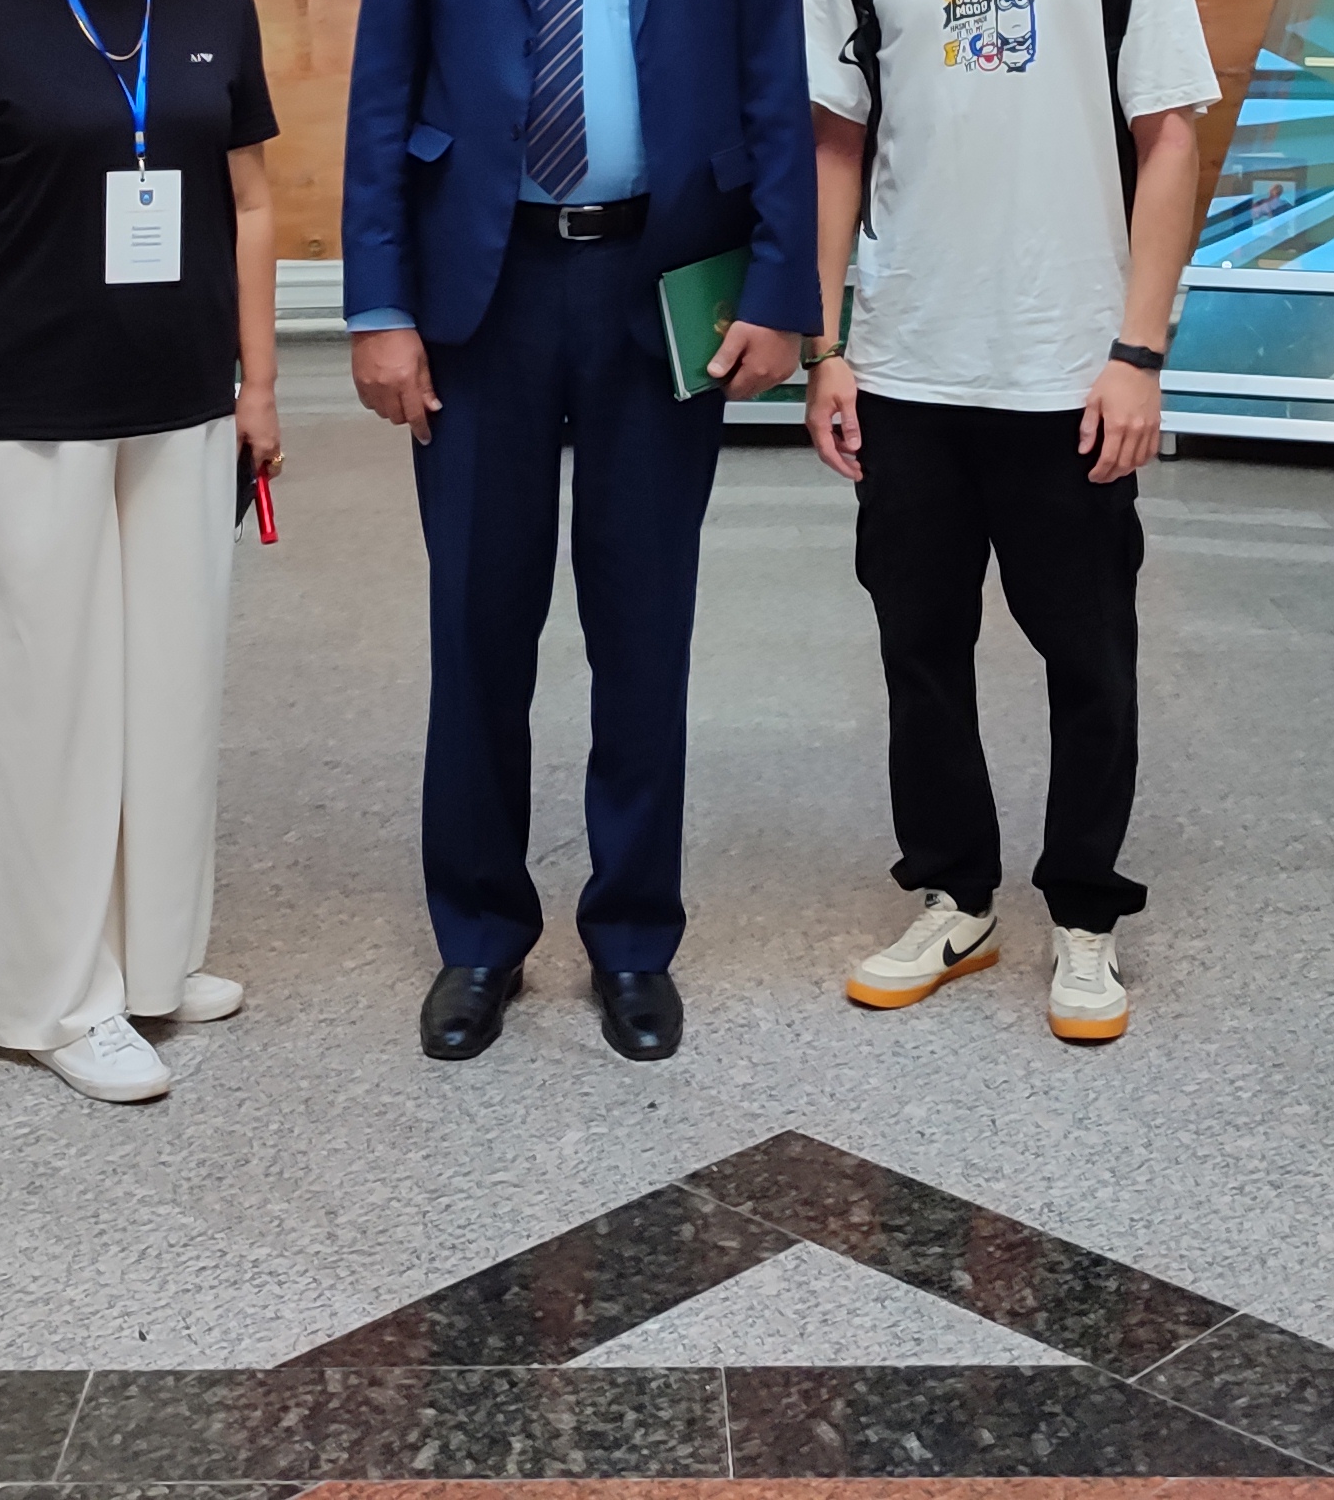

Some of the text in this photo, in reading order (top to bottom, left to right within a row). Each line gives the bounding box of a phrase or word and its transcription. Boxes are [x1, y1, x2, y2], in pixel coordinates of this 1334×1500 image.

[955, 0, 988, 18] MOOD
[943, 26, 996, 67] FACE
[963, 60, 977, 73] YET
